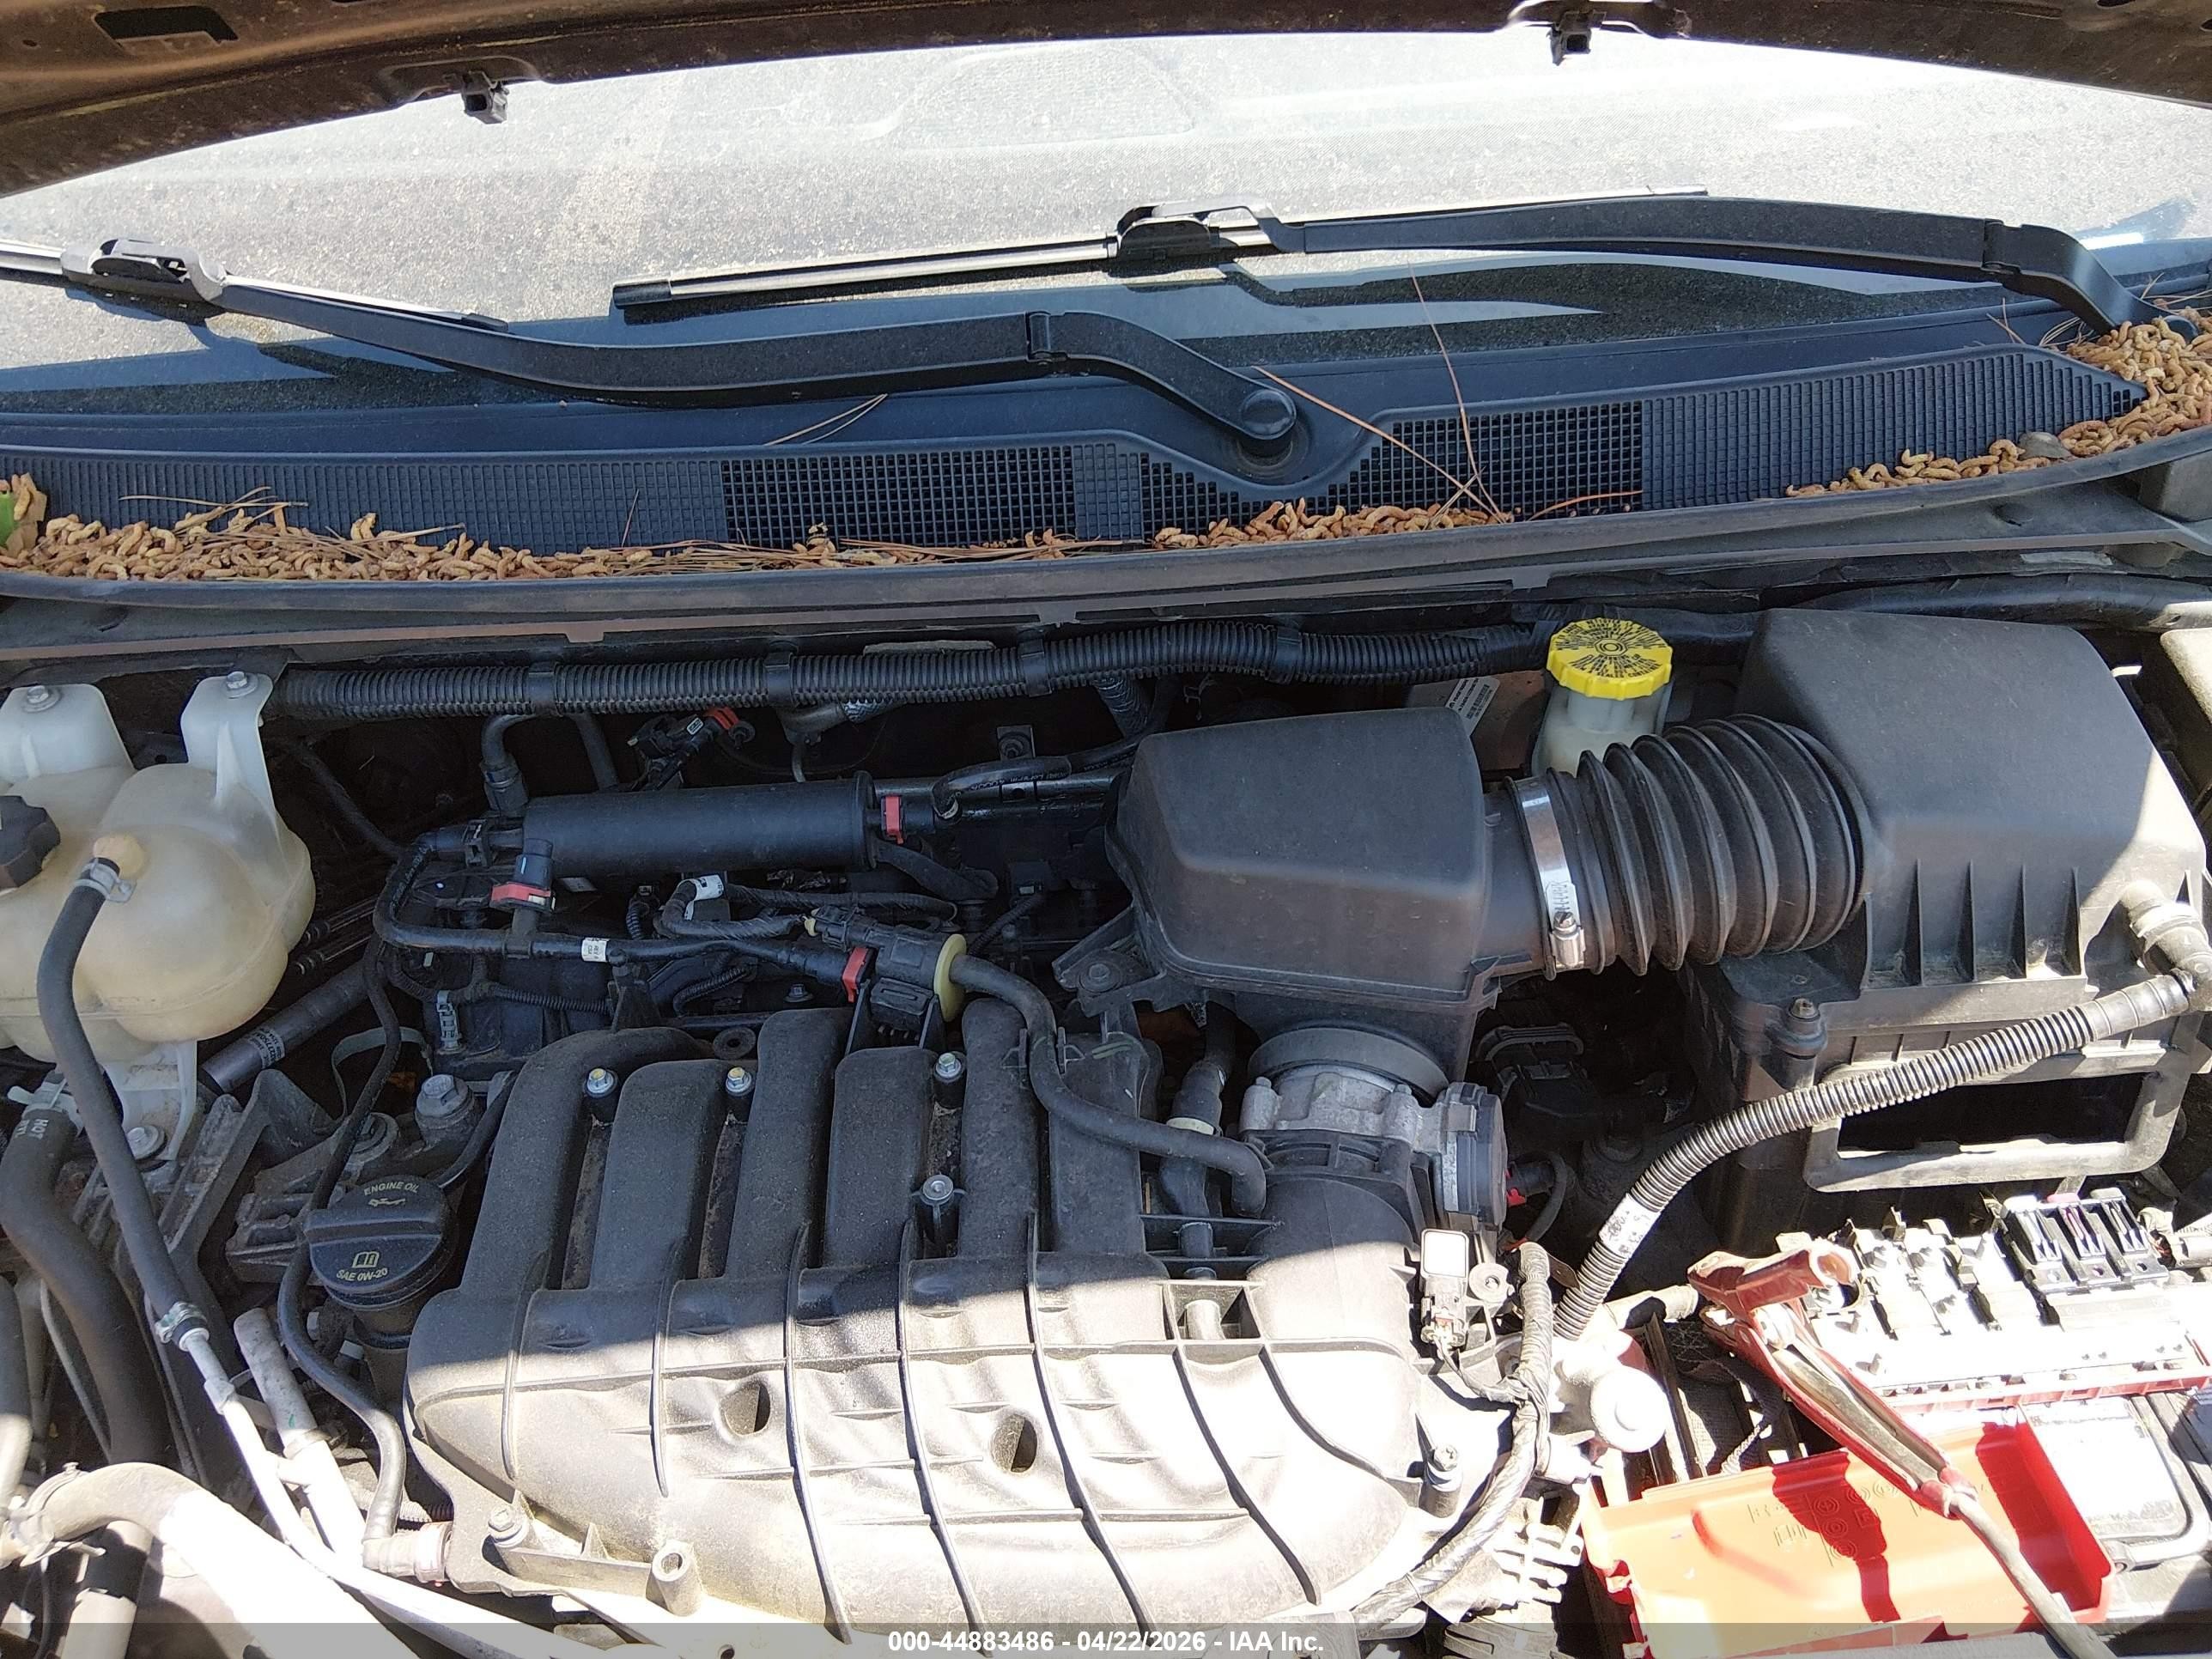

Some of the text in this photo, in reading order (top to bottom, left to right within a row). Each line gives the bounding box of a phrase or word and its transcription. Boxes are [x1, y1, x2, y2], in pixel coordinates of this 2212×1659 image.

[363, 1182, 419, 1196] ENGINE OIL
[336, 1267, 388, 1281] SAE 0W-20
